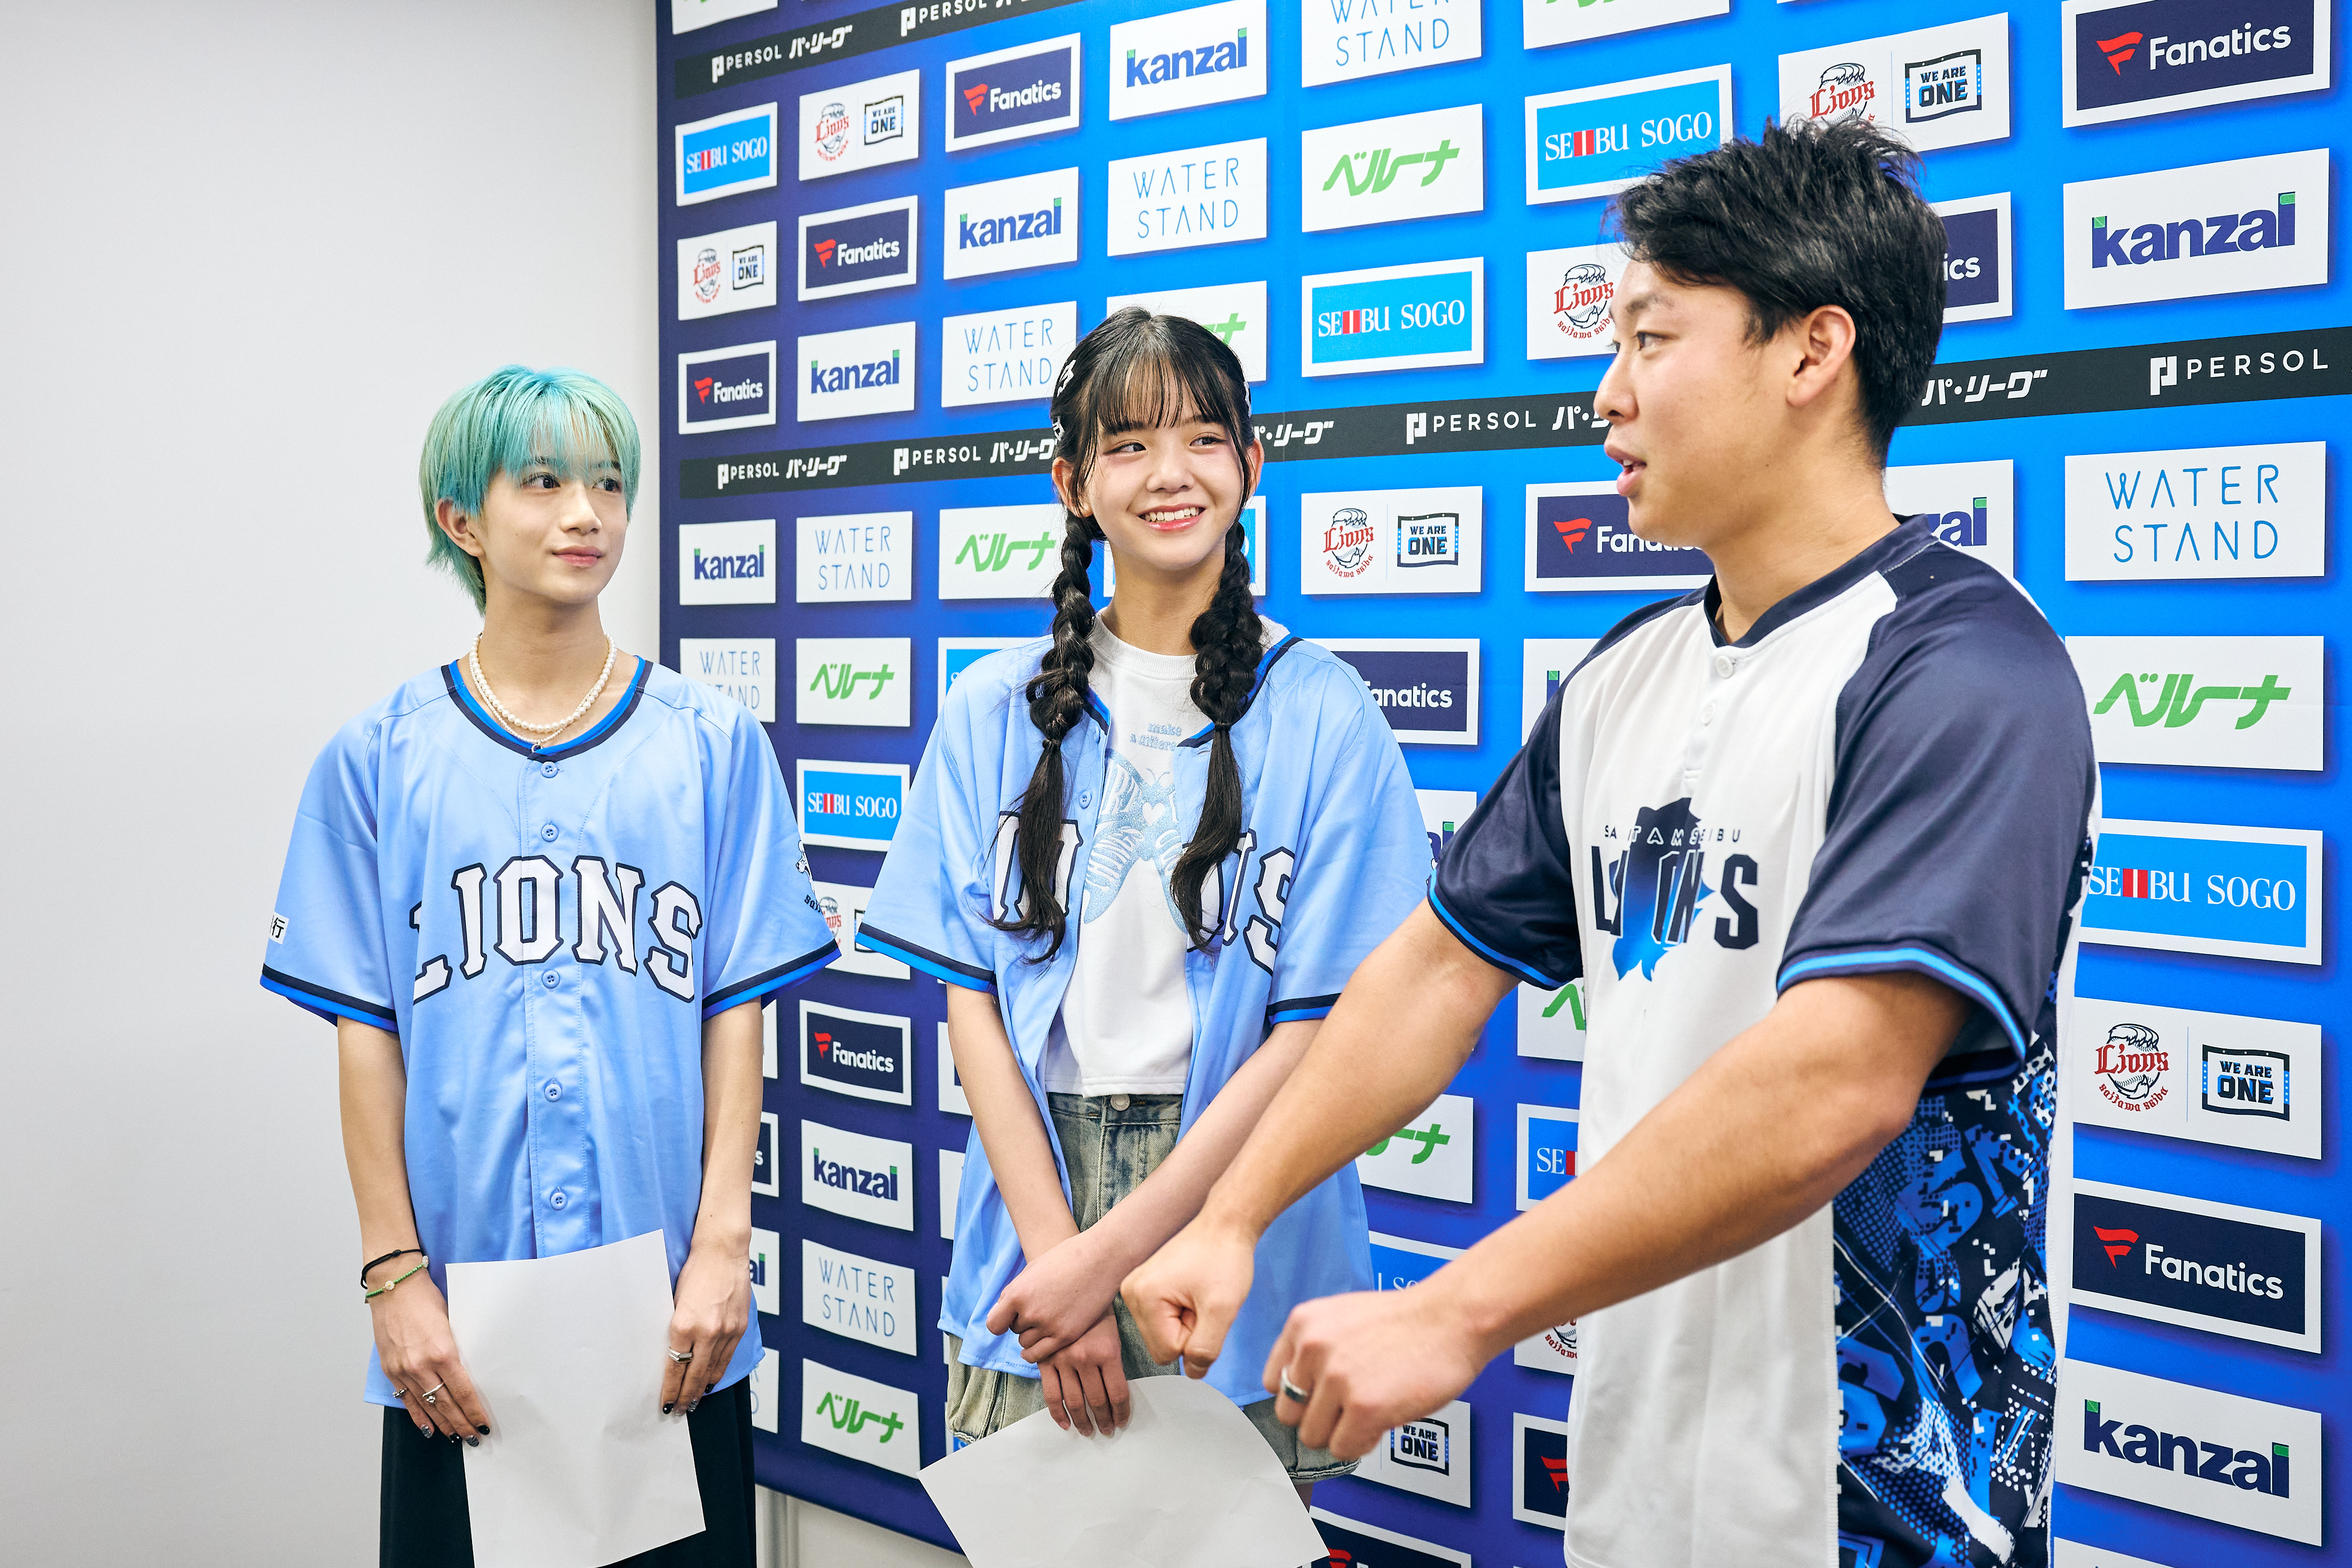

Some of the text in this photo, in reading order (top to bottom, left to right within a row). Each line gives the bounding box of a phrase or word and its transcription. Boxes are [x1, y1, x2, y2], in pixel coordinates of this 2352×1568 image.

[727, 45, 782, 71] PERSOL
[1126, 27, 1248, 88] kanzai
[1336, 19, 1449, 66] STAND
[2150, 23, 2291, 70] Fanatics
[1921, 65, 1966, 83] WE ARE
[990, 80, 1062, 112] Fanatics
[1809, 80, 1875, 121] Lions
[1918, 78, 1968, 108] ONE
[1641, 111, 1713, 148] SOGO
[732, 136, 767, 164] SOGO
[1134, 157, 1239, 199] WATER
[1321, 139, 1460, 197] ベルーナ
[959, 197, 1062, 250] kanzai
[1138, 199, 1239, 239] STAND
[2092, 191, 2296, 269] kanzai
[837, 237, 900, 267] Fanatics
[1400, 299, 1465, 330] SOGO
[1553, 282, 1614, 315] Lions
[964, 319, 1053, 355] WATER
[811, 349, 900, 395] kanzai
[968, 356, 1053, 393] STAND
[2187, 348, 2329, 379] PERSOL
[714, 378, 763, 404] Fanatics
[1921, 369, 2048, 407] パ・リーグ
[1433, 411, 1537, 433] PERSOL
[731, 454, 847, 481] PERSOL パ・リーグ
[912, 446, 981, 466] PERSOL
[2105, 465, 2280, 510] WATER
[815, 526, 891, 555] WATER
[1323, 525, 1374, 553] Lions
[1407, 536, 1448, 556] ONE
[1410, 525, 1447, 535] WE ARE
[2113, 520, 2278, 563] STAND
[694, 544, 765, 580] kanzai
[955, 532, 1057, 572] ベルーナ
[818, 562, 890, 590] STAND
[699, 651, 761, 676] WATER
[809, 663, 895, 700] ベルーナ
[1363, 681, 1453, 708] anatics
[2094, 673, 2292, 730] ベルーナ
[1138, 734, 1177, 751] differe
[1148, 723, 1182, 736] make
[856, 795, 898, 819] SOGO
[2207, 874, 2297, 912] SOGO
[269, 914, 285, 939] 行
[832, 1041, 894, 1074] Fanatics
[2094, 1043, 2170, 1075] Lions
[2219, 1060, 2273, 1079] WE ARE
[2217, 1075, 2274, 1105] ONE
[813, 1148, 898, 1201] kanzai
[818, 1256, 895, 1303] WATER
[2144, 1243, 2284, 1300] Fanatics
[822, 1294, 896, 1337] STAND
[816, 1391, 904, 1444] ベルーナ
[1402, 1424, 1437, 1441] WE ARE
[1400, 1434, 1439, 1462] ONE
[2084, 1398, 2290, 1500] kanzai
